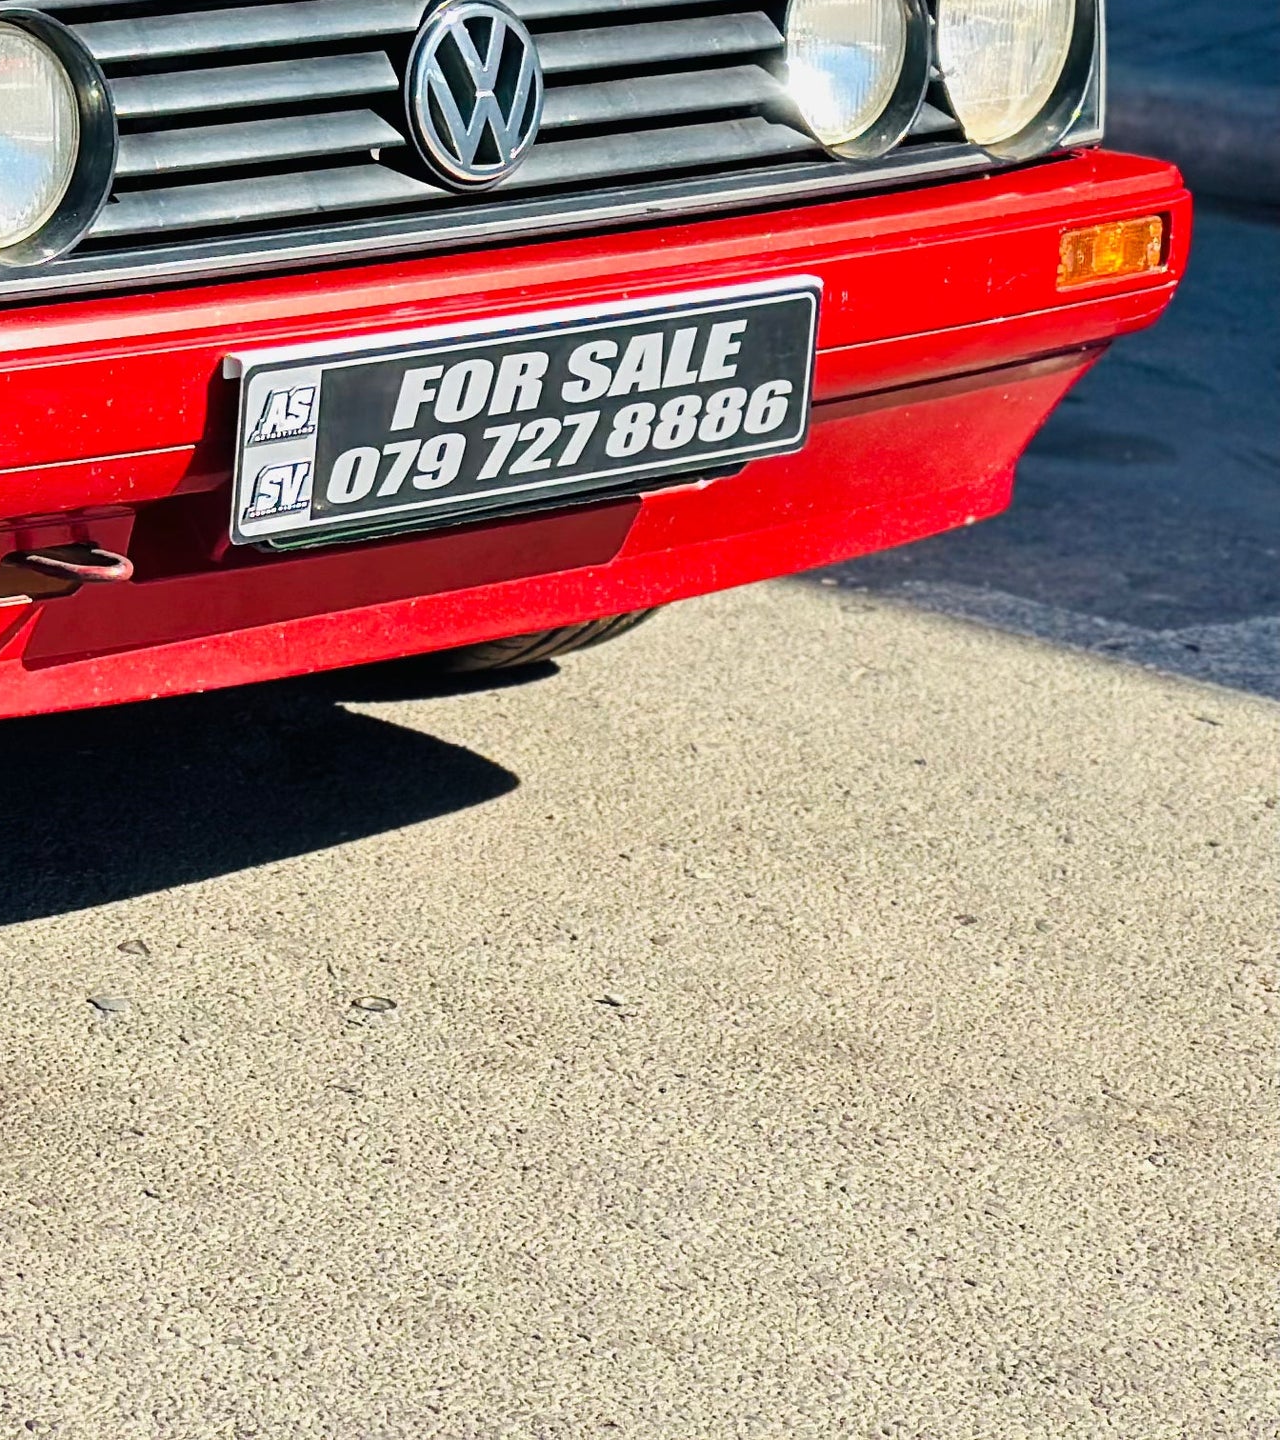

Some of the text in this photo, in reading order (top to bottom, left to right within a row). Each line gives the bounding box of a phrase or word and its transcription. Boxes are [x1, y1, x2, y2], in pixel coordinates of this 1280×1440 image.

[260, 386, 316, 434] AS
[390, 318, 748, 431] FOR SALE
[326, 378, 793, 505] 079 727 8886
